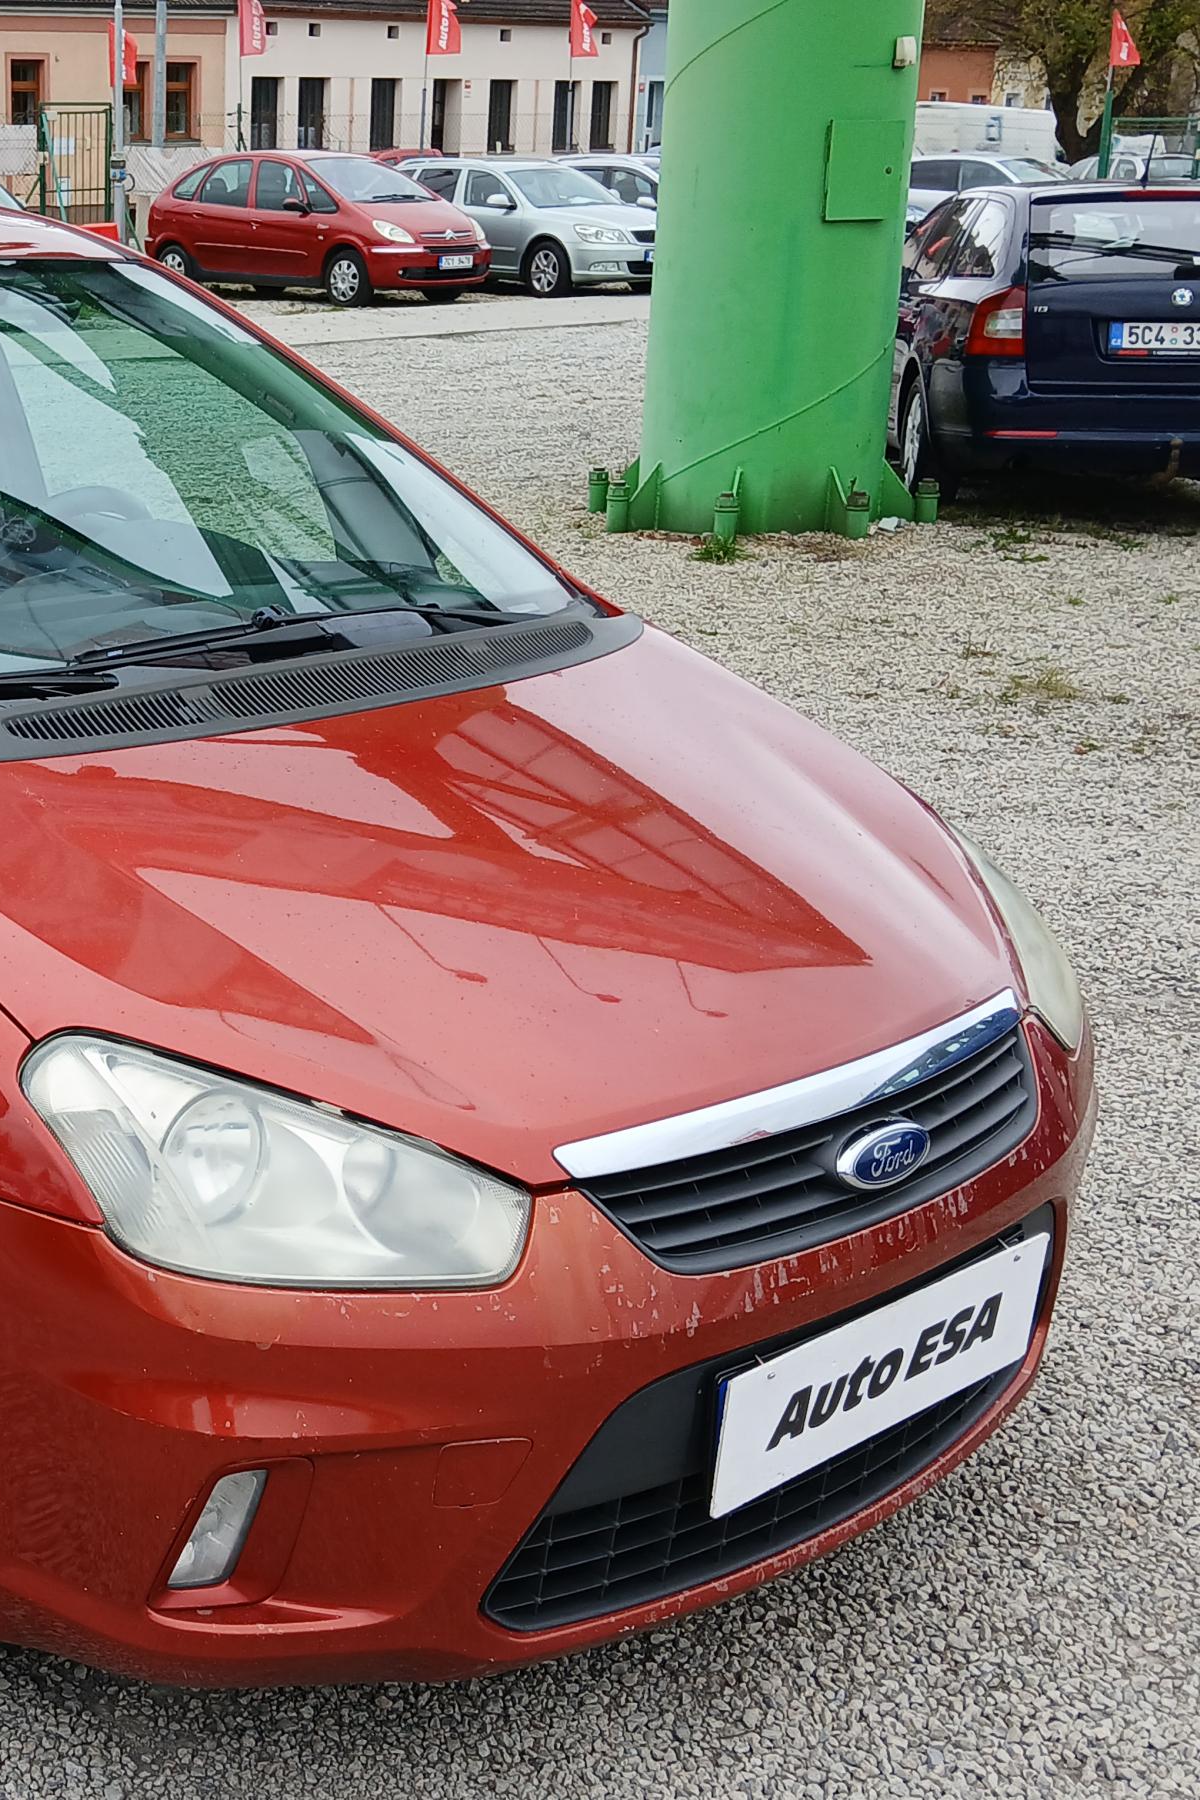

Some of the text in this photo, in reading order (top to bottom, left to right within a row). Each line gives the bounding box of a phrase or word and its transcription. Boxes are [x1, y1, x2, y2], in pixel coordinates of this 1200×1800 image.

[251, 16, 262, 50] Auto
[438, 17, 449, 50] Auto
[1128, 325, 1165, 345] 5C4
[870, 1137, 916, 1178] Ford
[764, 1291, 1004, 1452] Auto ESA
